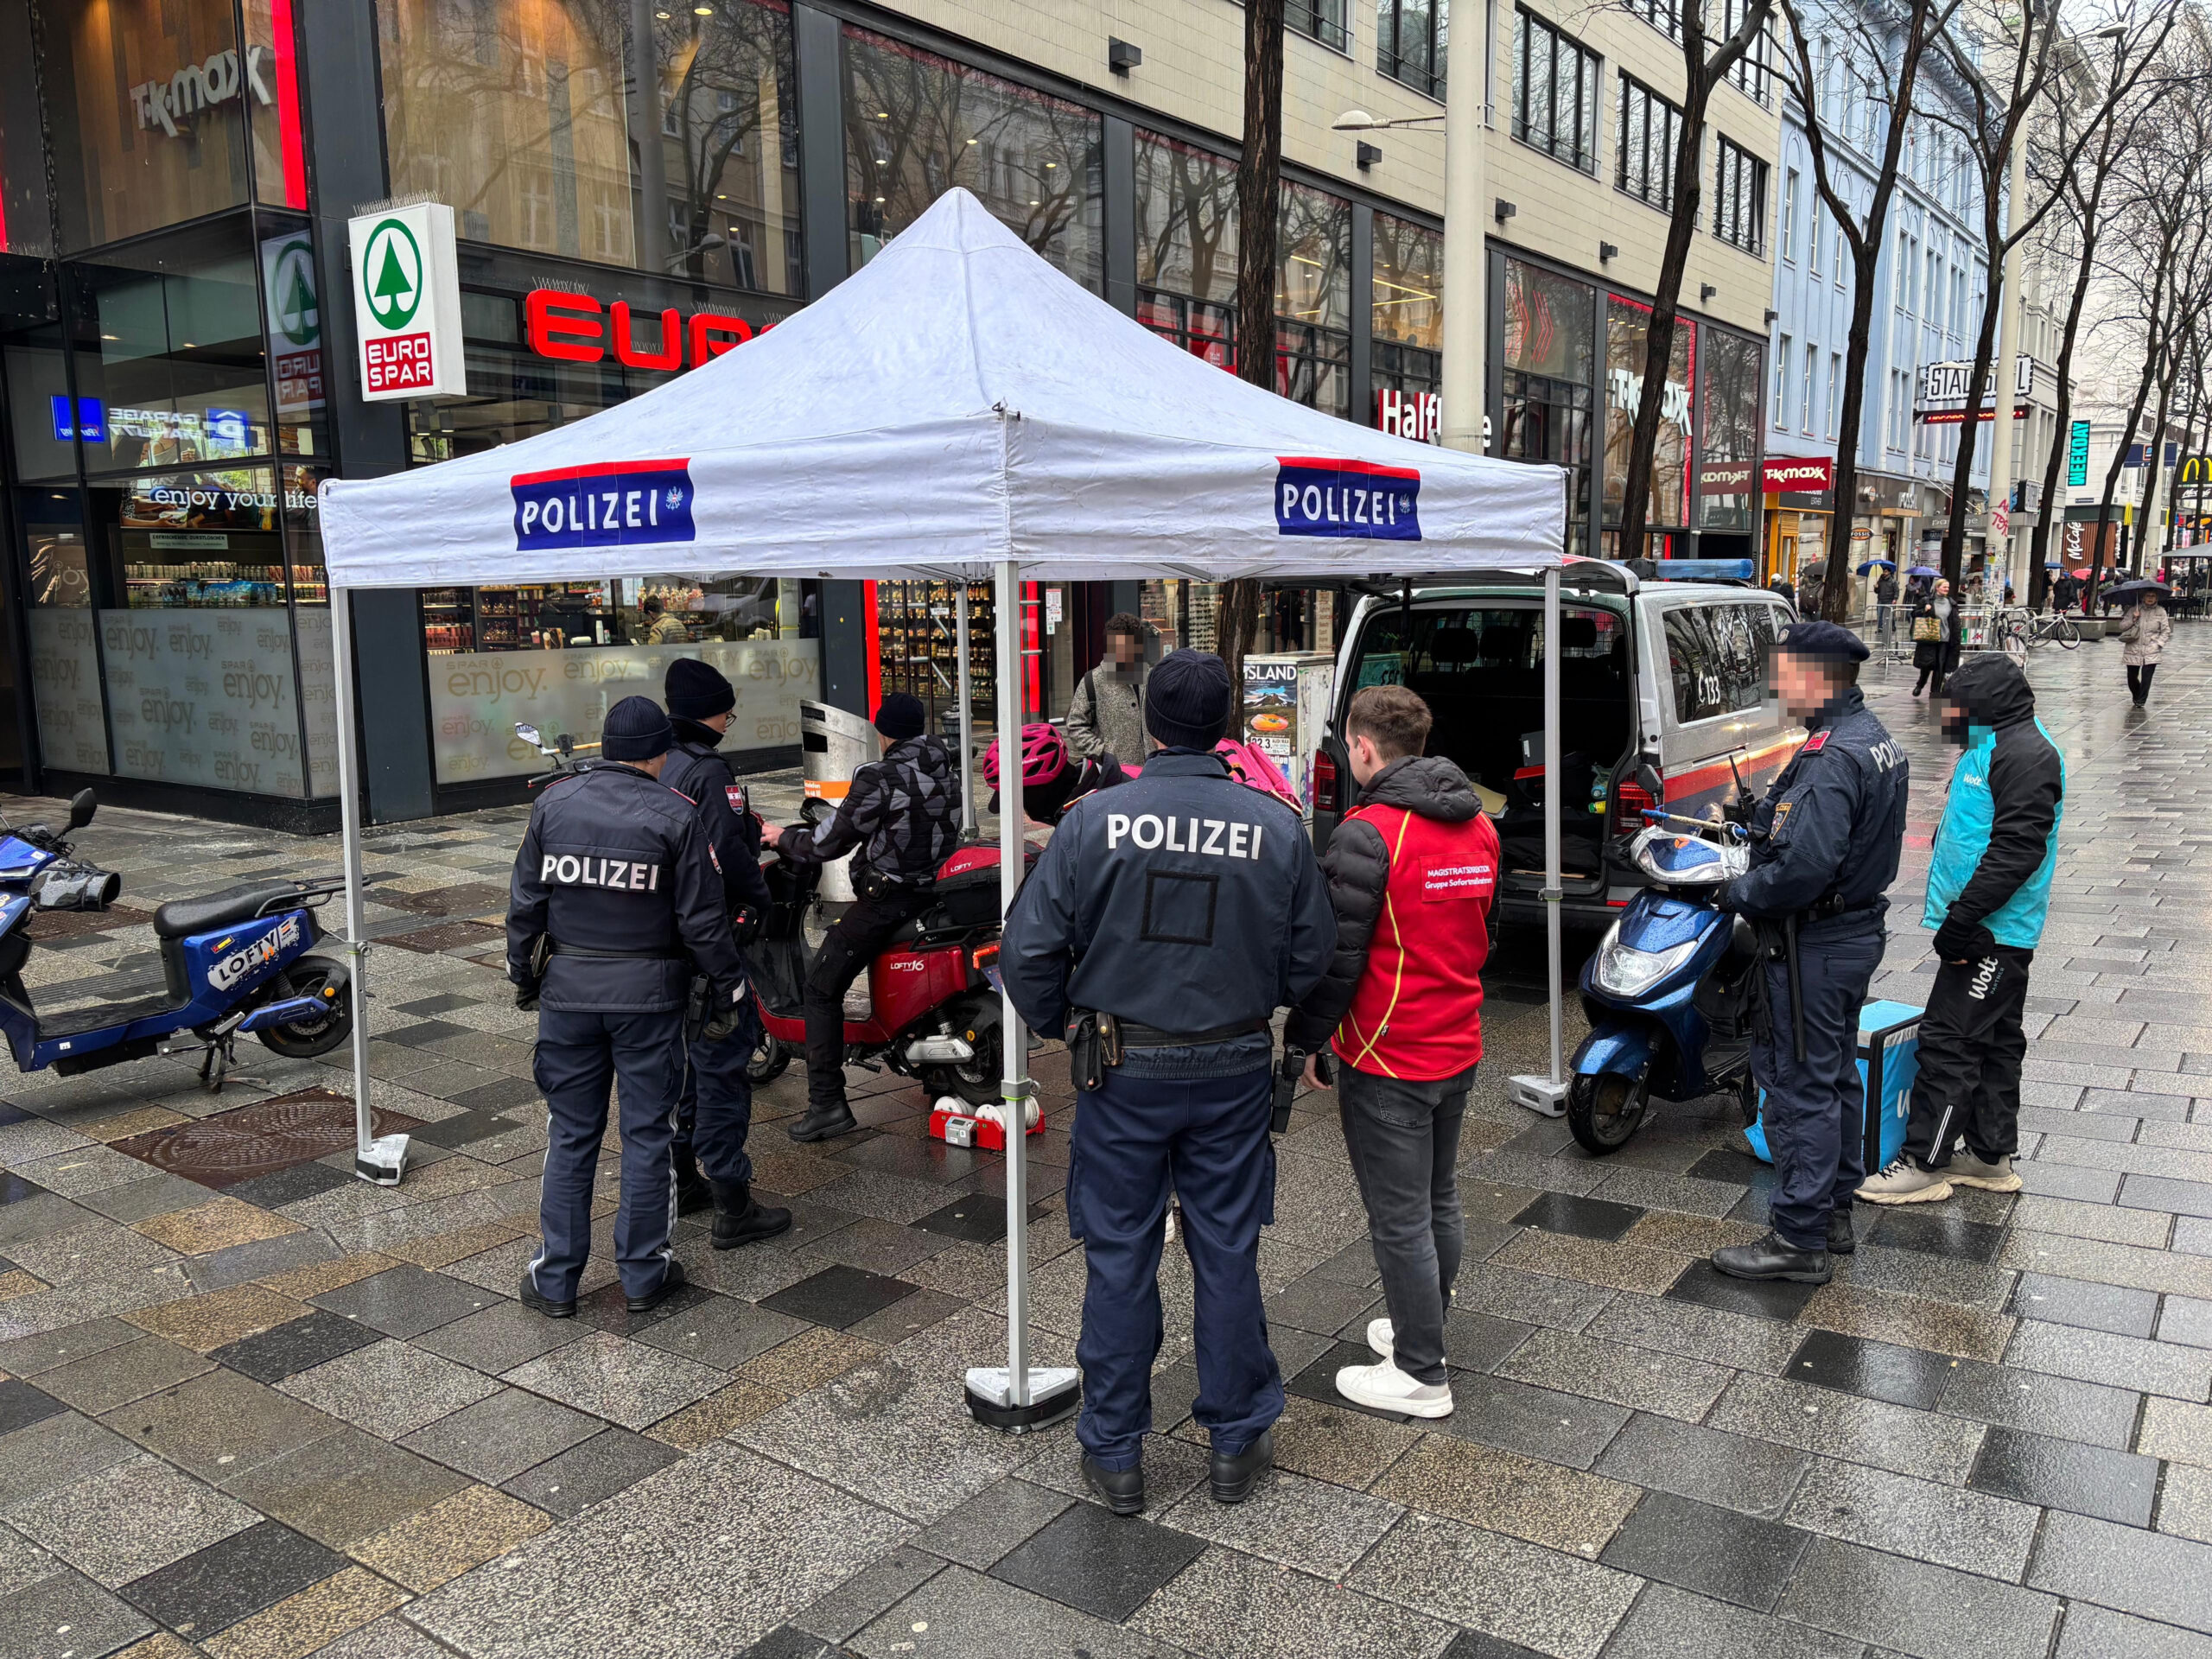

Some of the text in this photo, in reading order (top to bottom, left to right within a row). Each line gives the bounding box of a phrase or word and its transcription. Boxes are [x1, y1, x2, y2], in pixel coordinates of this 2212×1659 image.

[526, 289, 778, 372] EUR
[368, 339, 429, 364] EURO
[370, 362, 431, 387] SPAR
[1382, 388, 1437, 441] Half
[2069, 422, 2089, 486] WEEKDAY
[155, 486, 318, 511] enjoy your life
[521, 489, 658, 535] POLIZEI
[1282, 483, 1396, 525] POLIZEI
[1932, 518, 1979, 526] page
[297, 615, 333, 632] enjo
[105, 624, 160, 660] enjoy.
[221, 660, 246, 670] SPAR
[446, 659, 489, 670] SPAR
[563, 658, 632, 684] enjoy.
[223, 671, 286, 709] enjoy.
[448, 668, 548, 704] enjoy.
[1705, 675, 1720, 705] 133
[141, 698, 197, 734] enjoy.
[251, 730, 298, 760] enjoy.
[757, 720, 800, 744] enjo
[1962, 772, 1982, 786] Wolt
[1106, 814, 1262, 861] POLIZEI
[540, 854, 660, 892] POLIZEI
[950, 861, 972, 873] LOFTY
[1425, 880, 1448, 890] Gruppe
[219, 931, 276, 982] LOFTY
[1968, 956, 1999, 1000] Wolt
[1990, 967, 2005, 995] PARTNER
